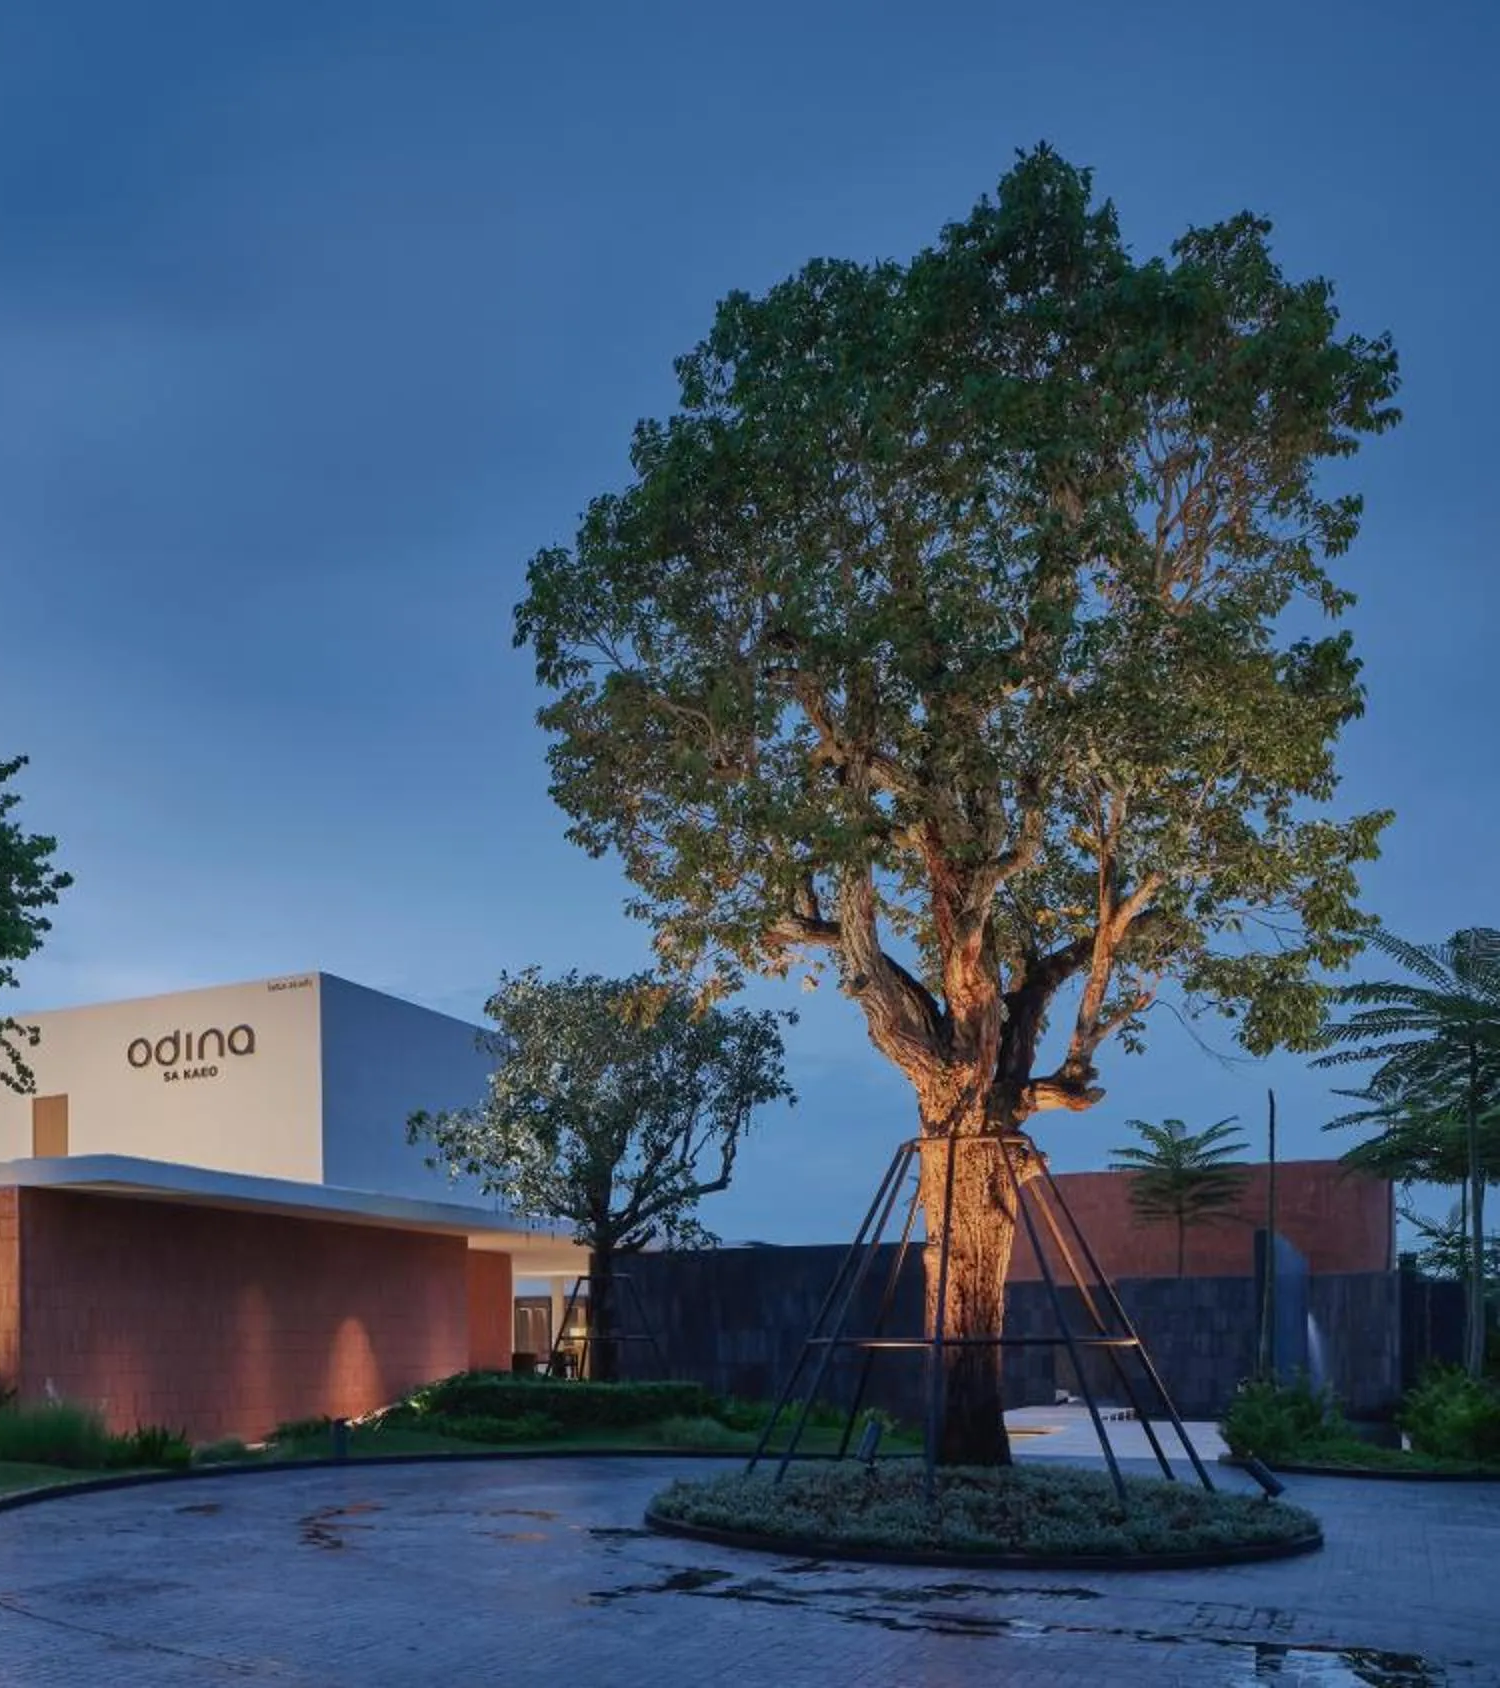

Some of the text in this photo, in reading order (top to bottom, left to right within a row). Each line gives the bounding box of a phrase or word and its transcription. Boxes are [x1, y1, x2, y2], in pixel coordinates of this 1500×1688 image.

[127, 1023, 255, 1069] odina
[162, 1064, 218, 1083] SA KAEO
